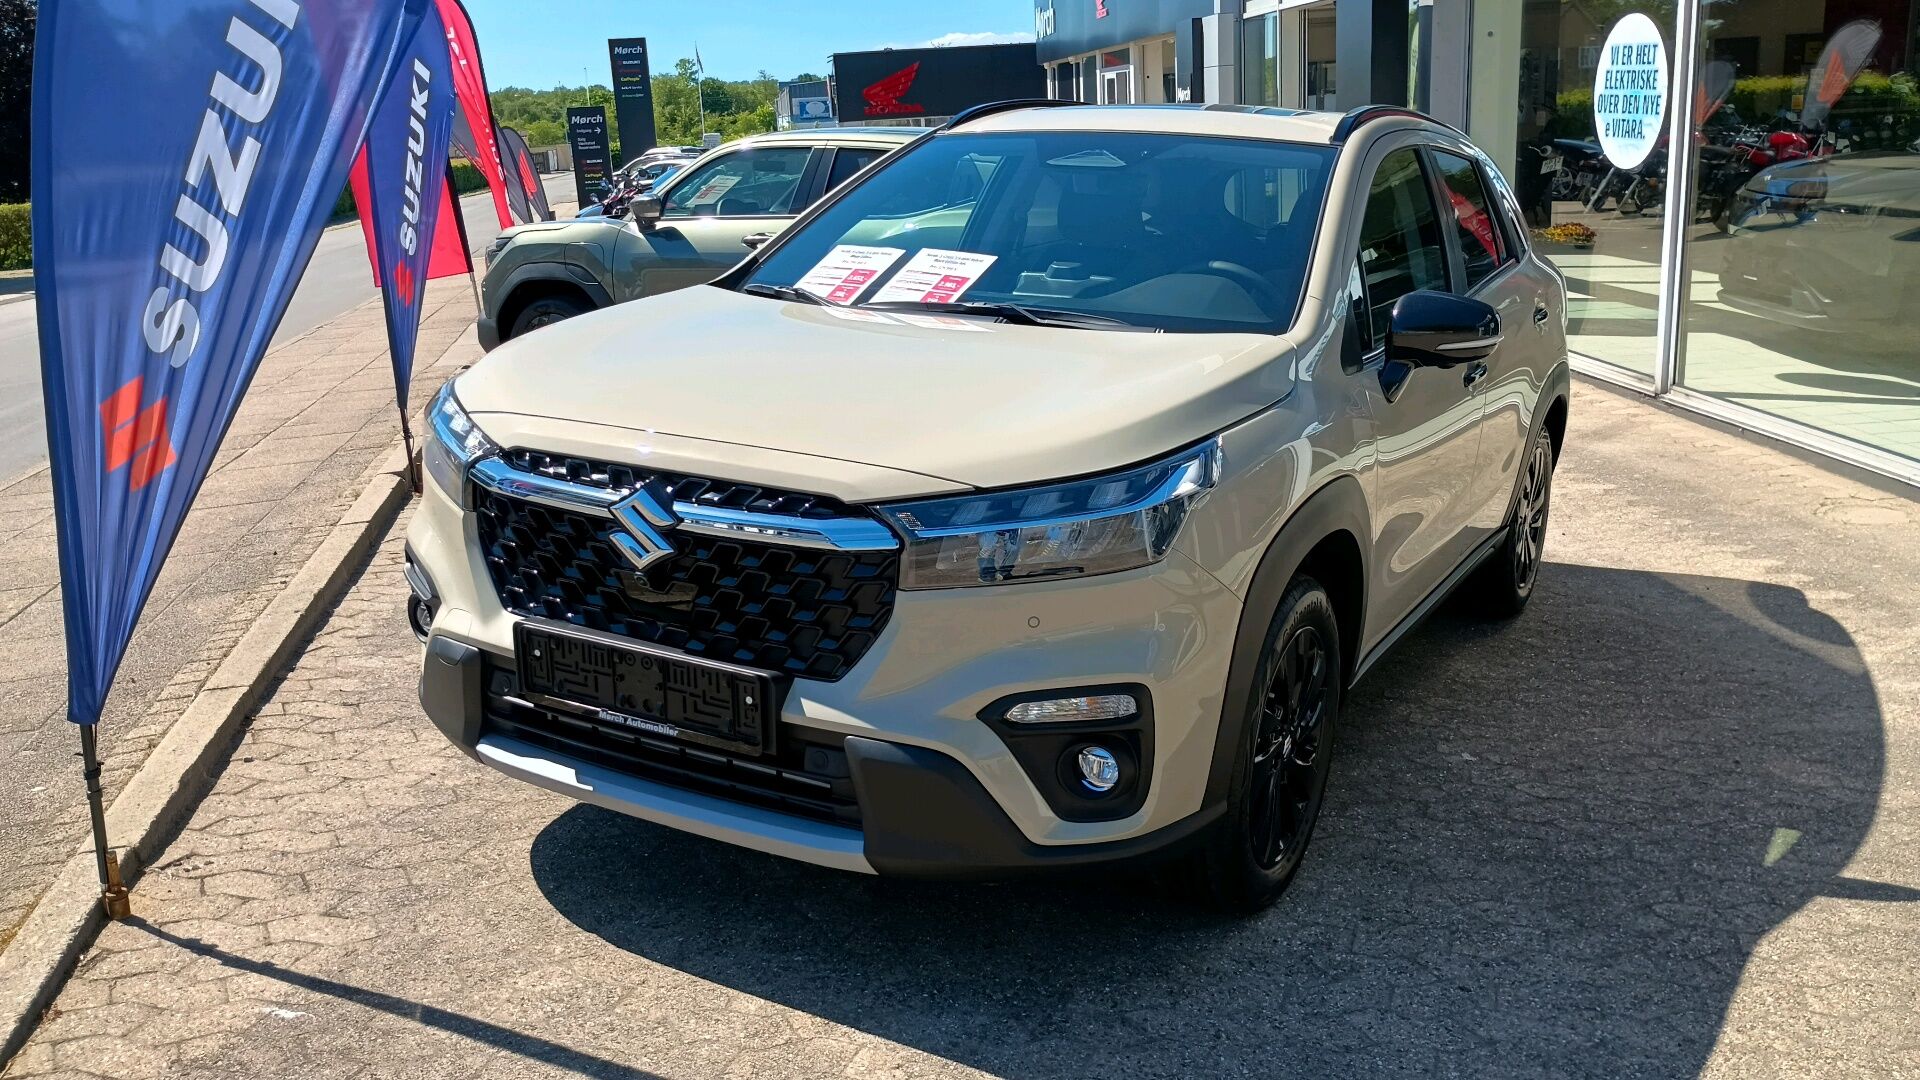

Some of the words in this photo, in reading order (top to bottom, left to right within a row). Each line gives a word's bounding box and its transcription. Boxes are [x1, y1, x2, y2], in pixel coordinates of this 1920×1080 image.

[614, 45, 643, 55] Mørch
[1611, 46, 1618, 65] VI
[1622, 45, 1632, 65] ER
[1636, 44, 1658, 65] HELT
[1605, 70, 1658, 90] ELEKTRISKE
[1597, 94, 1618, 114] OVER
[1621, 95, 1639, 115] DEN
[1642, 95, 1661, 115] NYE
[571, 114, 603, 125] Mørch
[1605, 123, 1610, 137] e
[1612, 118, 1645, 139] VITARA.
[400, 58, 431, 256] SUZUKI
[142, 0, 300, 369] SUZU
[626, 717, 679, 737] Automobiler
